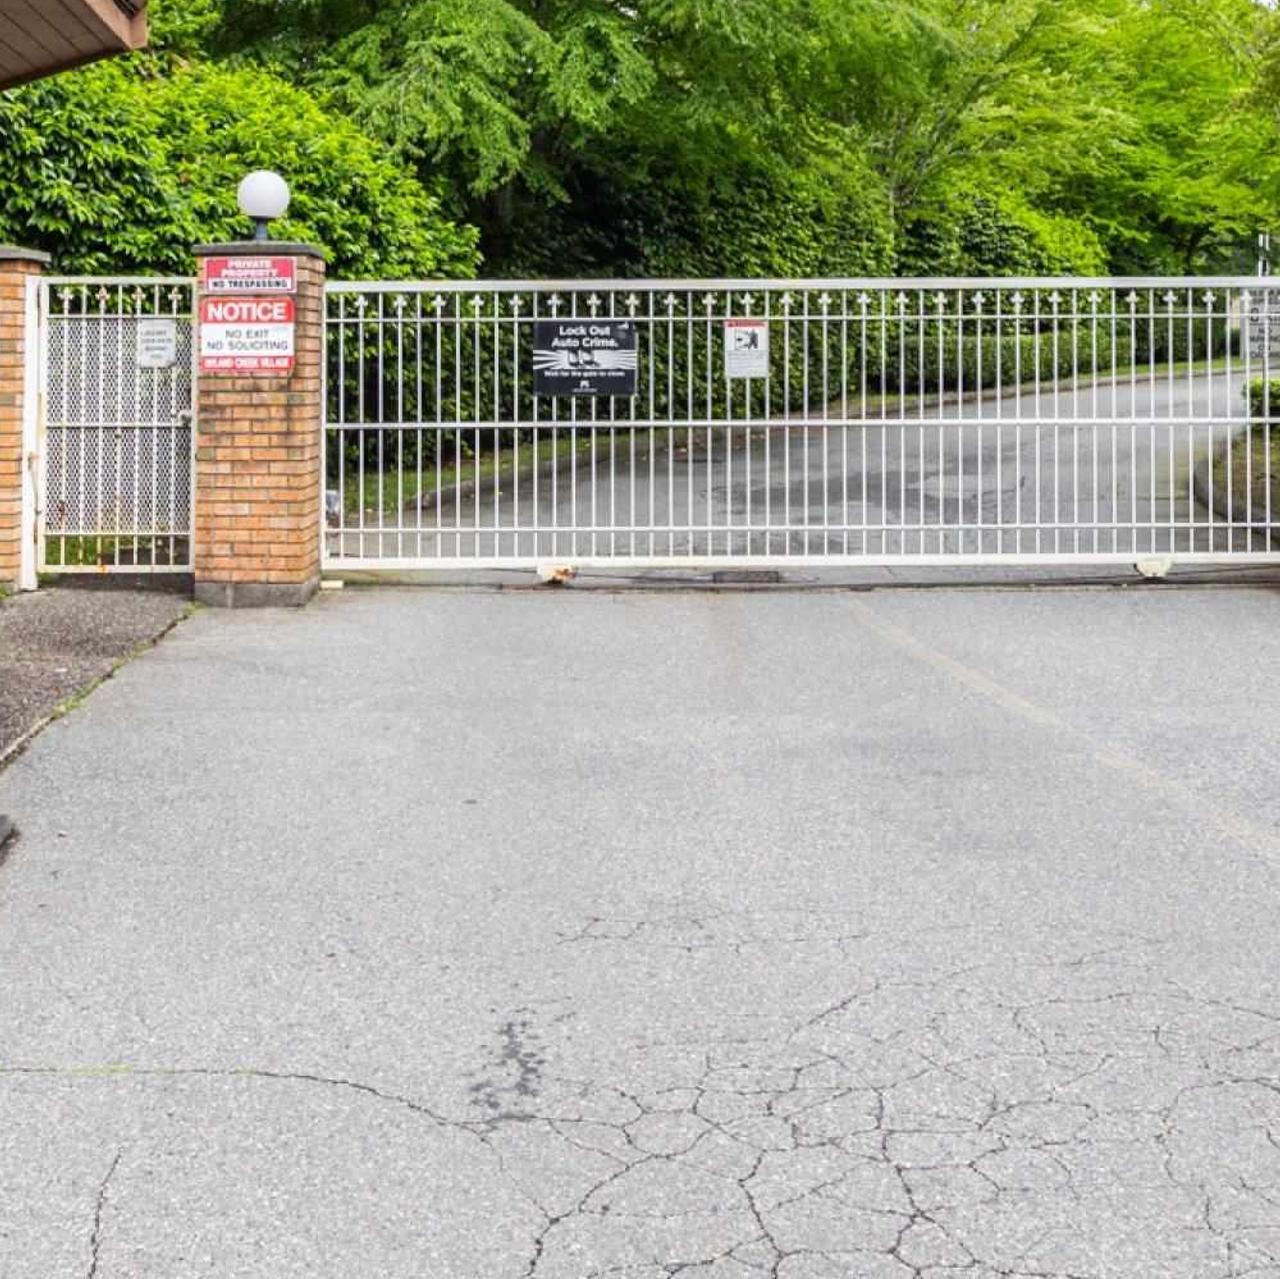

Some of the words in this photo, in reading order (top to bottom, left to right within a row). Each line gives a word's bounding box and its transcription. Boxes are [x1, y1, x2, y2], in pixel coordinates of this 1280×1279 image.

[213, 280, 225, 288] NO
[229, 280, 288, 288] TRESPASSING
[207, 302, 288, 321] NOTICE
[225, 329, 242, 339] NO
[246, 329, 270, 339] EXIT
[559, 325, 587, 336] Lock
[589, 326, 611, 336] Out
[207, 340, 223, 351] NO
[228, 340, 288, 351] SOLICITING
[551, 338, 580, 348] Auto
